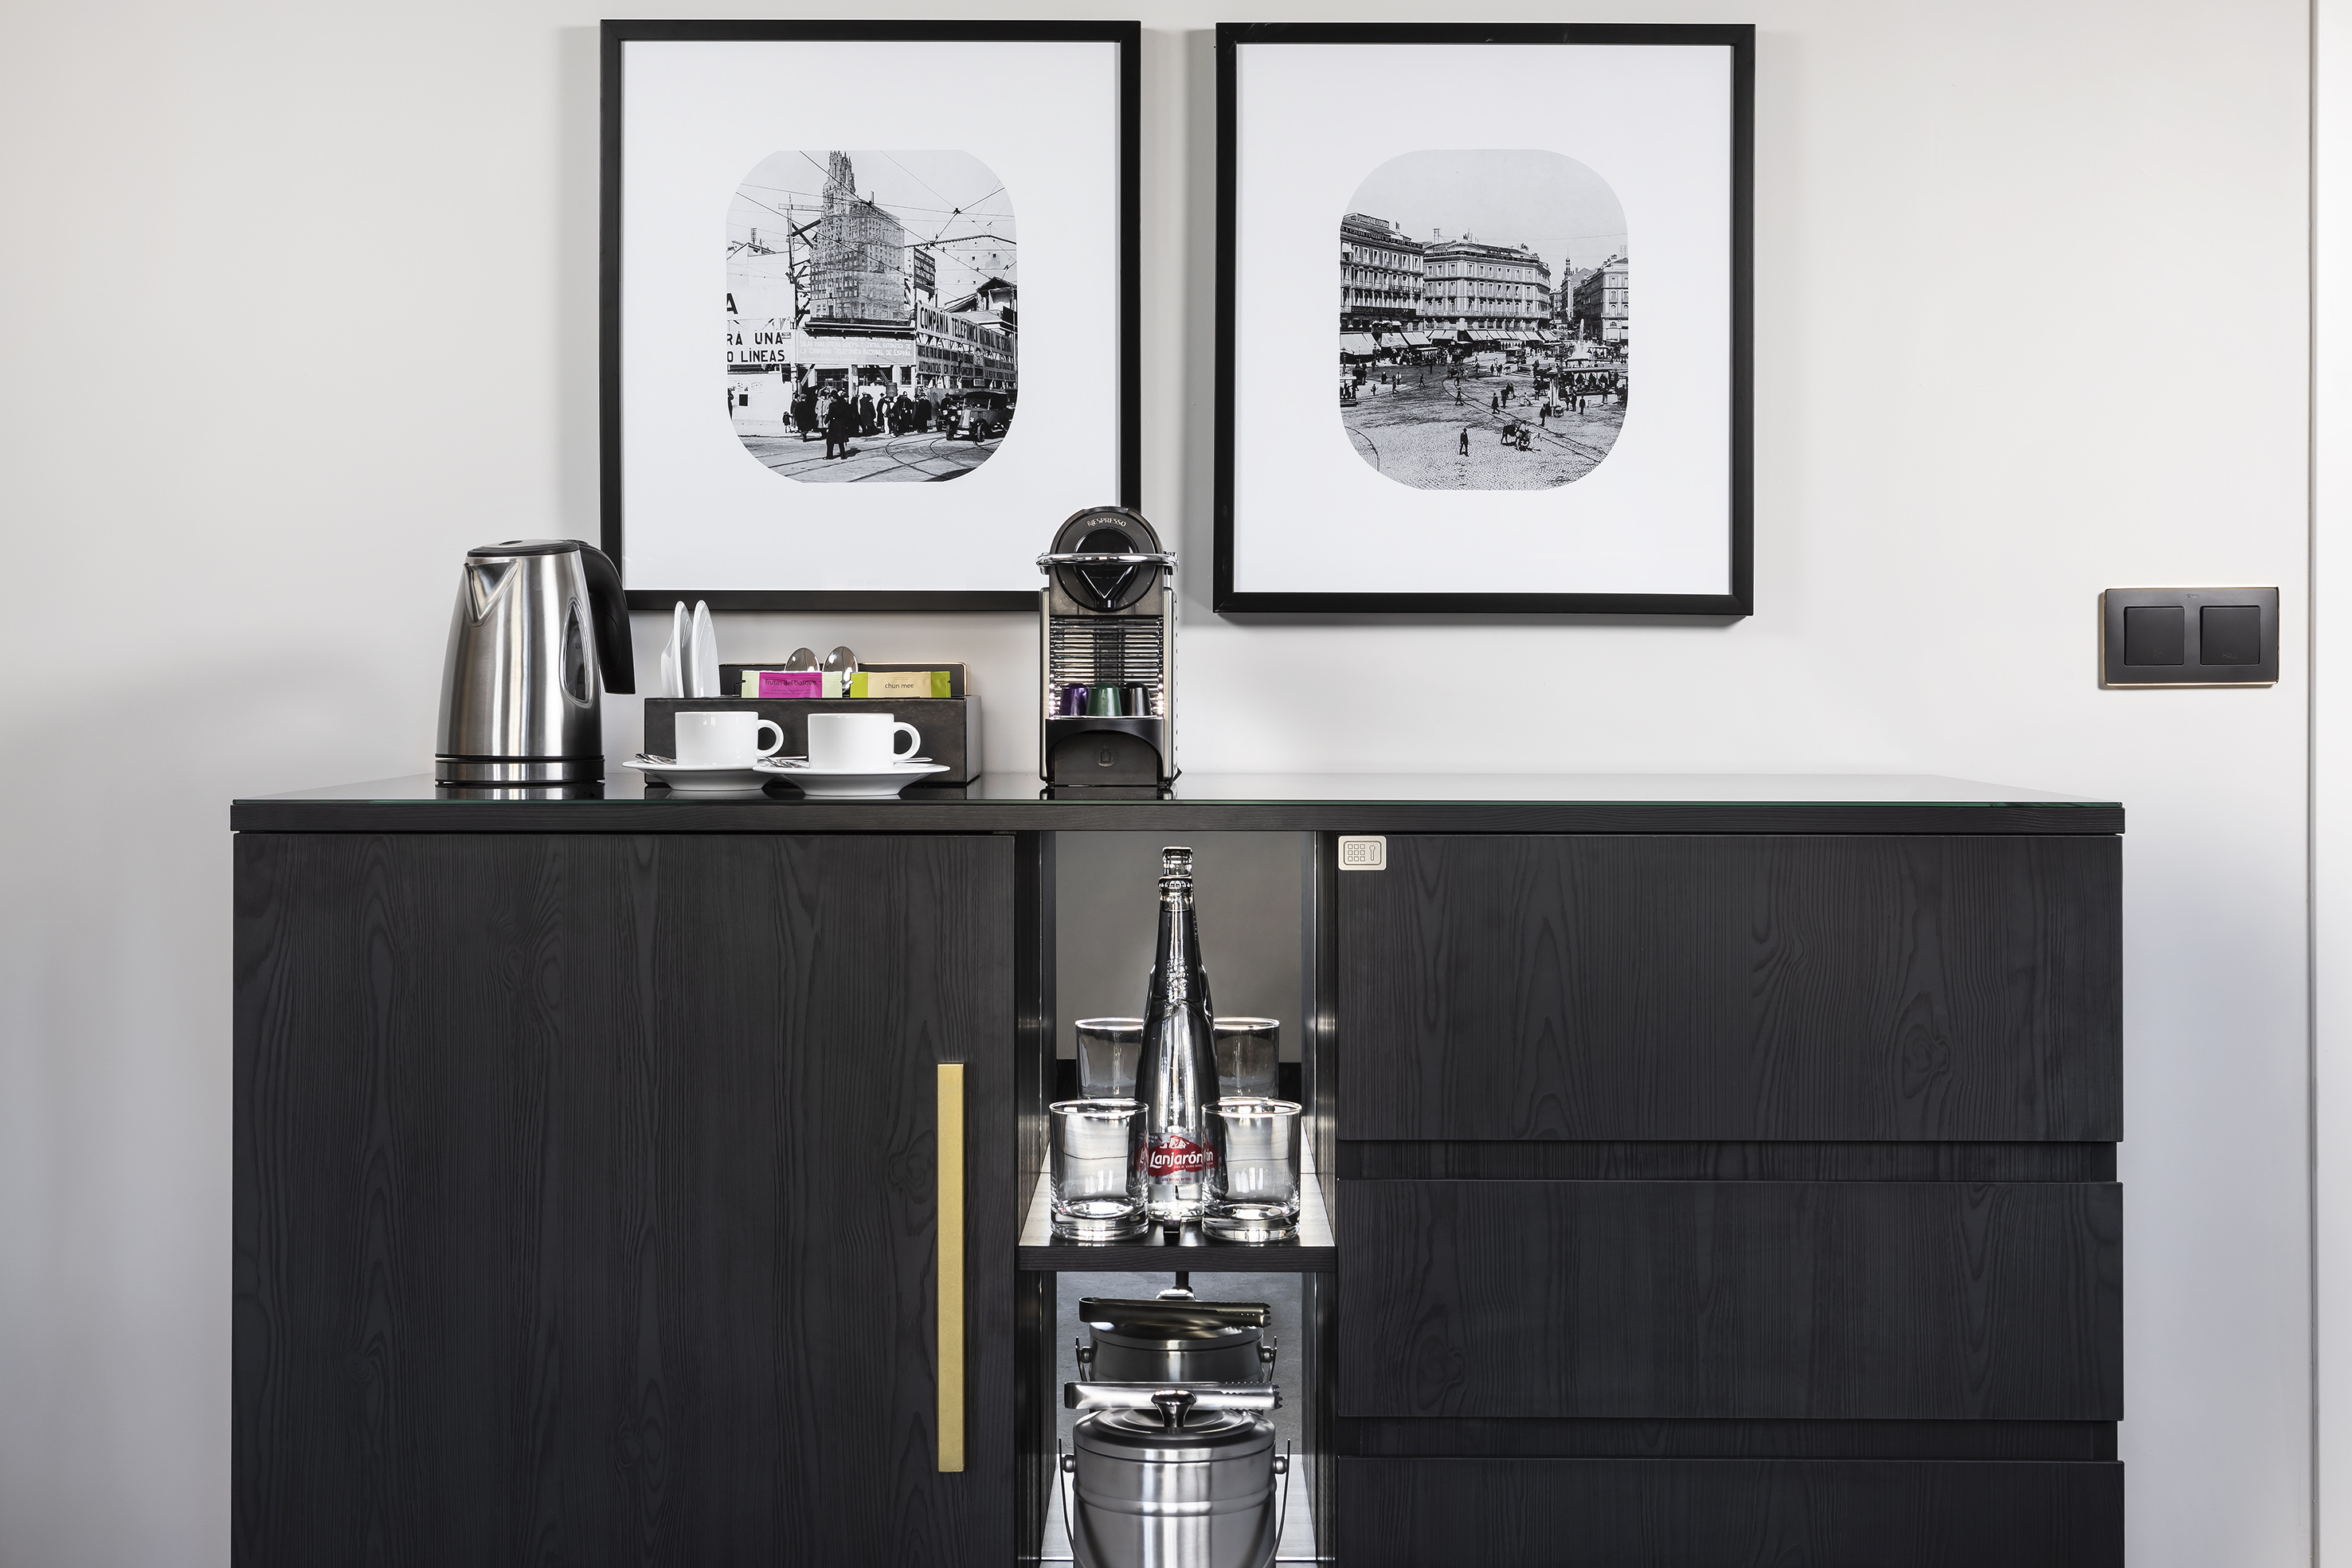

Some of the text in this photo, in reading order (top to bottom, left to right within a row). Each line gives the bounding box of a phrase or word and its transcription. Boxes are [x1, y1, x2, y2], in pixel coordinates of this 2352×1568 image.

[755, 332, 783, 345] UNA
[1086, 517, 1126, 527] NESPRESSO
[1149, 1151, 1203, 1169] Lanjarón
